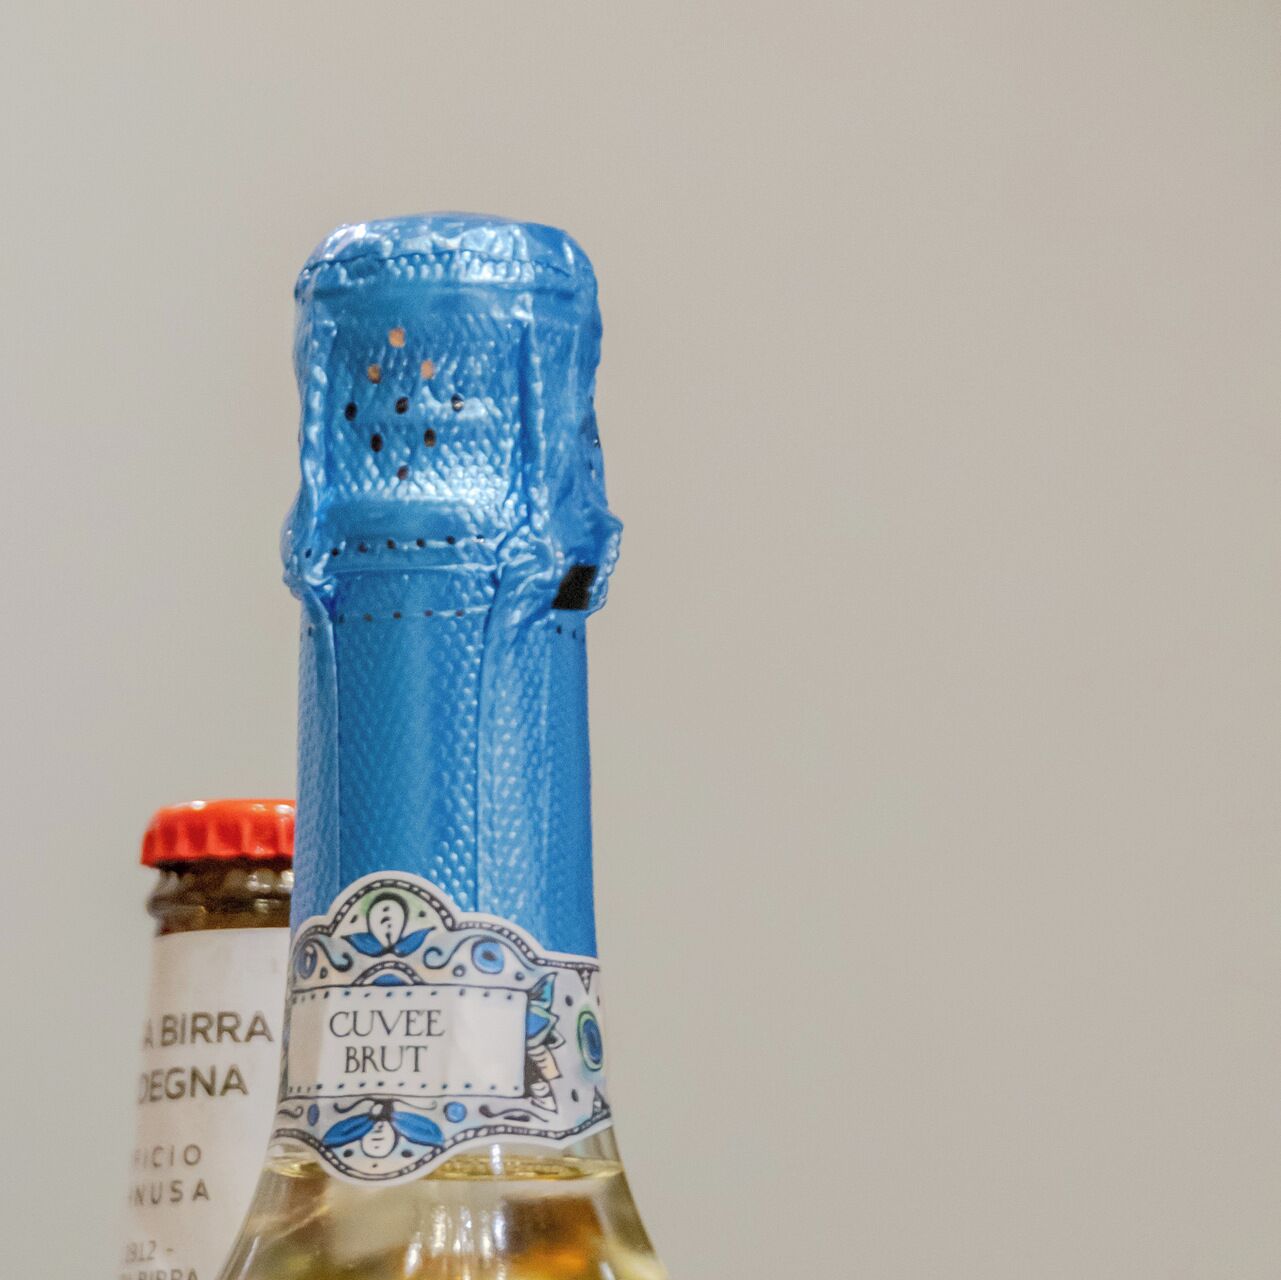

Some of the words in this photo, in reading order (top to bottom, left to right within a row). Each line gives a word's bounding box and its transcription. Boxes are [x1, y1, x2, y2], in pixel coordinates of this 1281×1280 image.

[159, 1010, 275, 1047] BIRRA
[328, 1009, 446, 1038] CUVEE
[344, 1046, 429, 1074] BRUT
